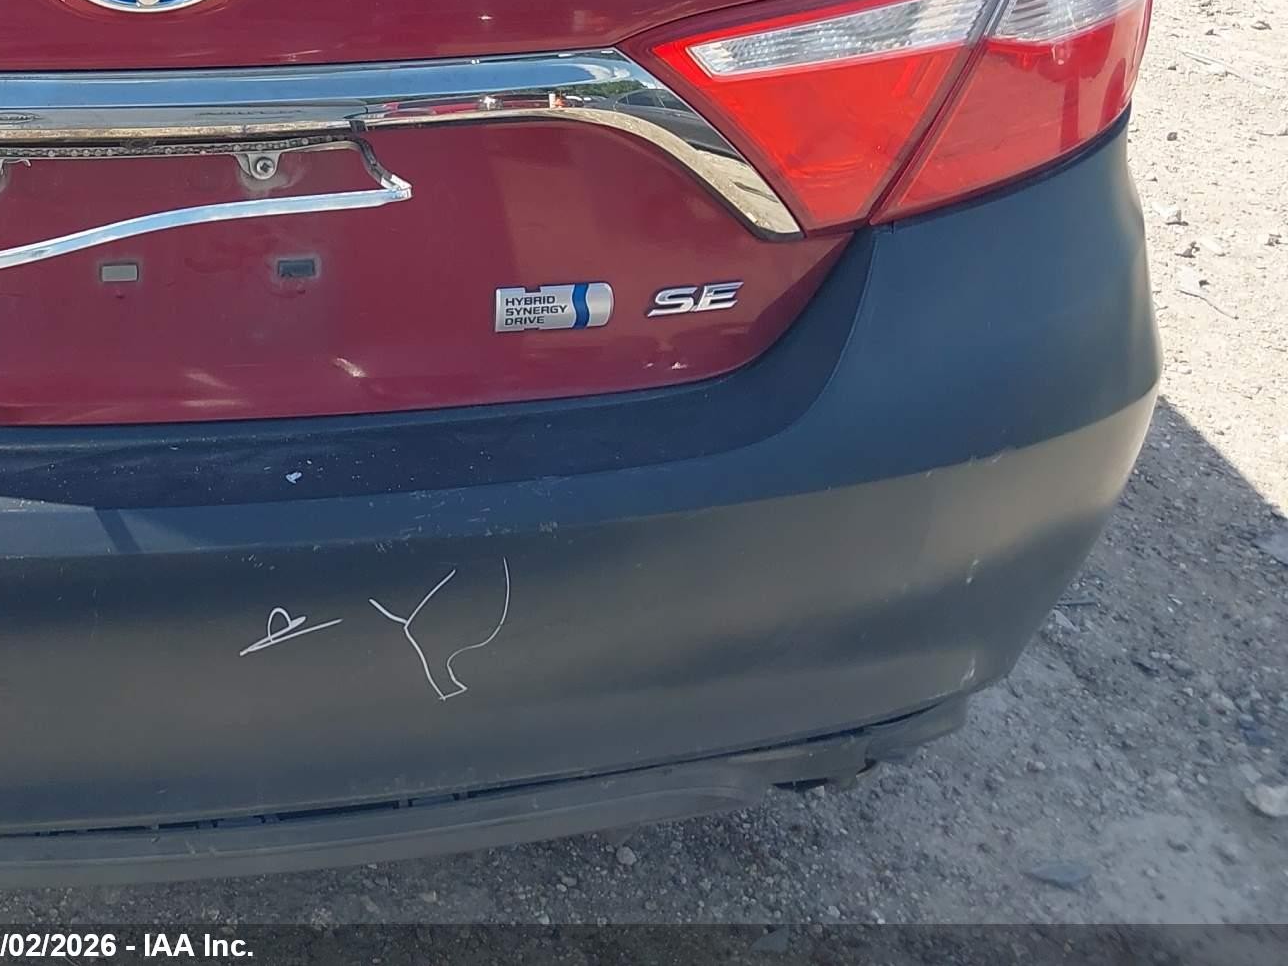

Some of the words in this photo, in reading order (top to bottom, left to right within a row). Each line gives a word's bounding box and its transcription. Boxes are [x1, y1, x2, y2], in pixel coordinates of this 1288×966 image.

[505, 295, 556, 307] HYBRID
[647, 281, 744, 318] SE
[505, 304, 568, 317] SYNERGY
[504, 316, 545, 326] DRIVE
